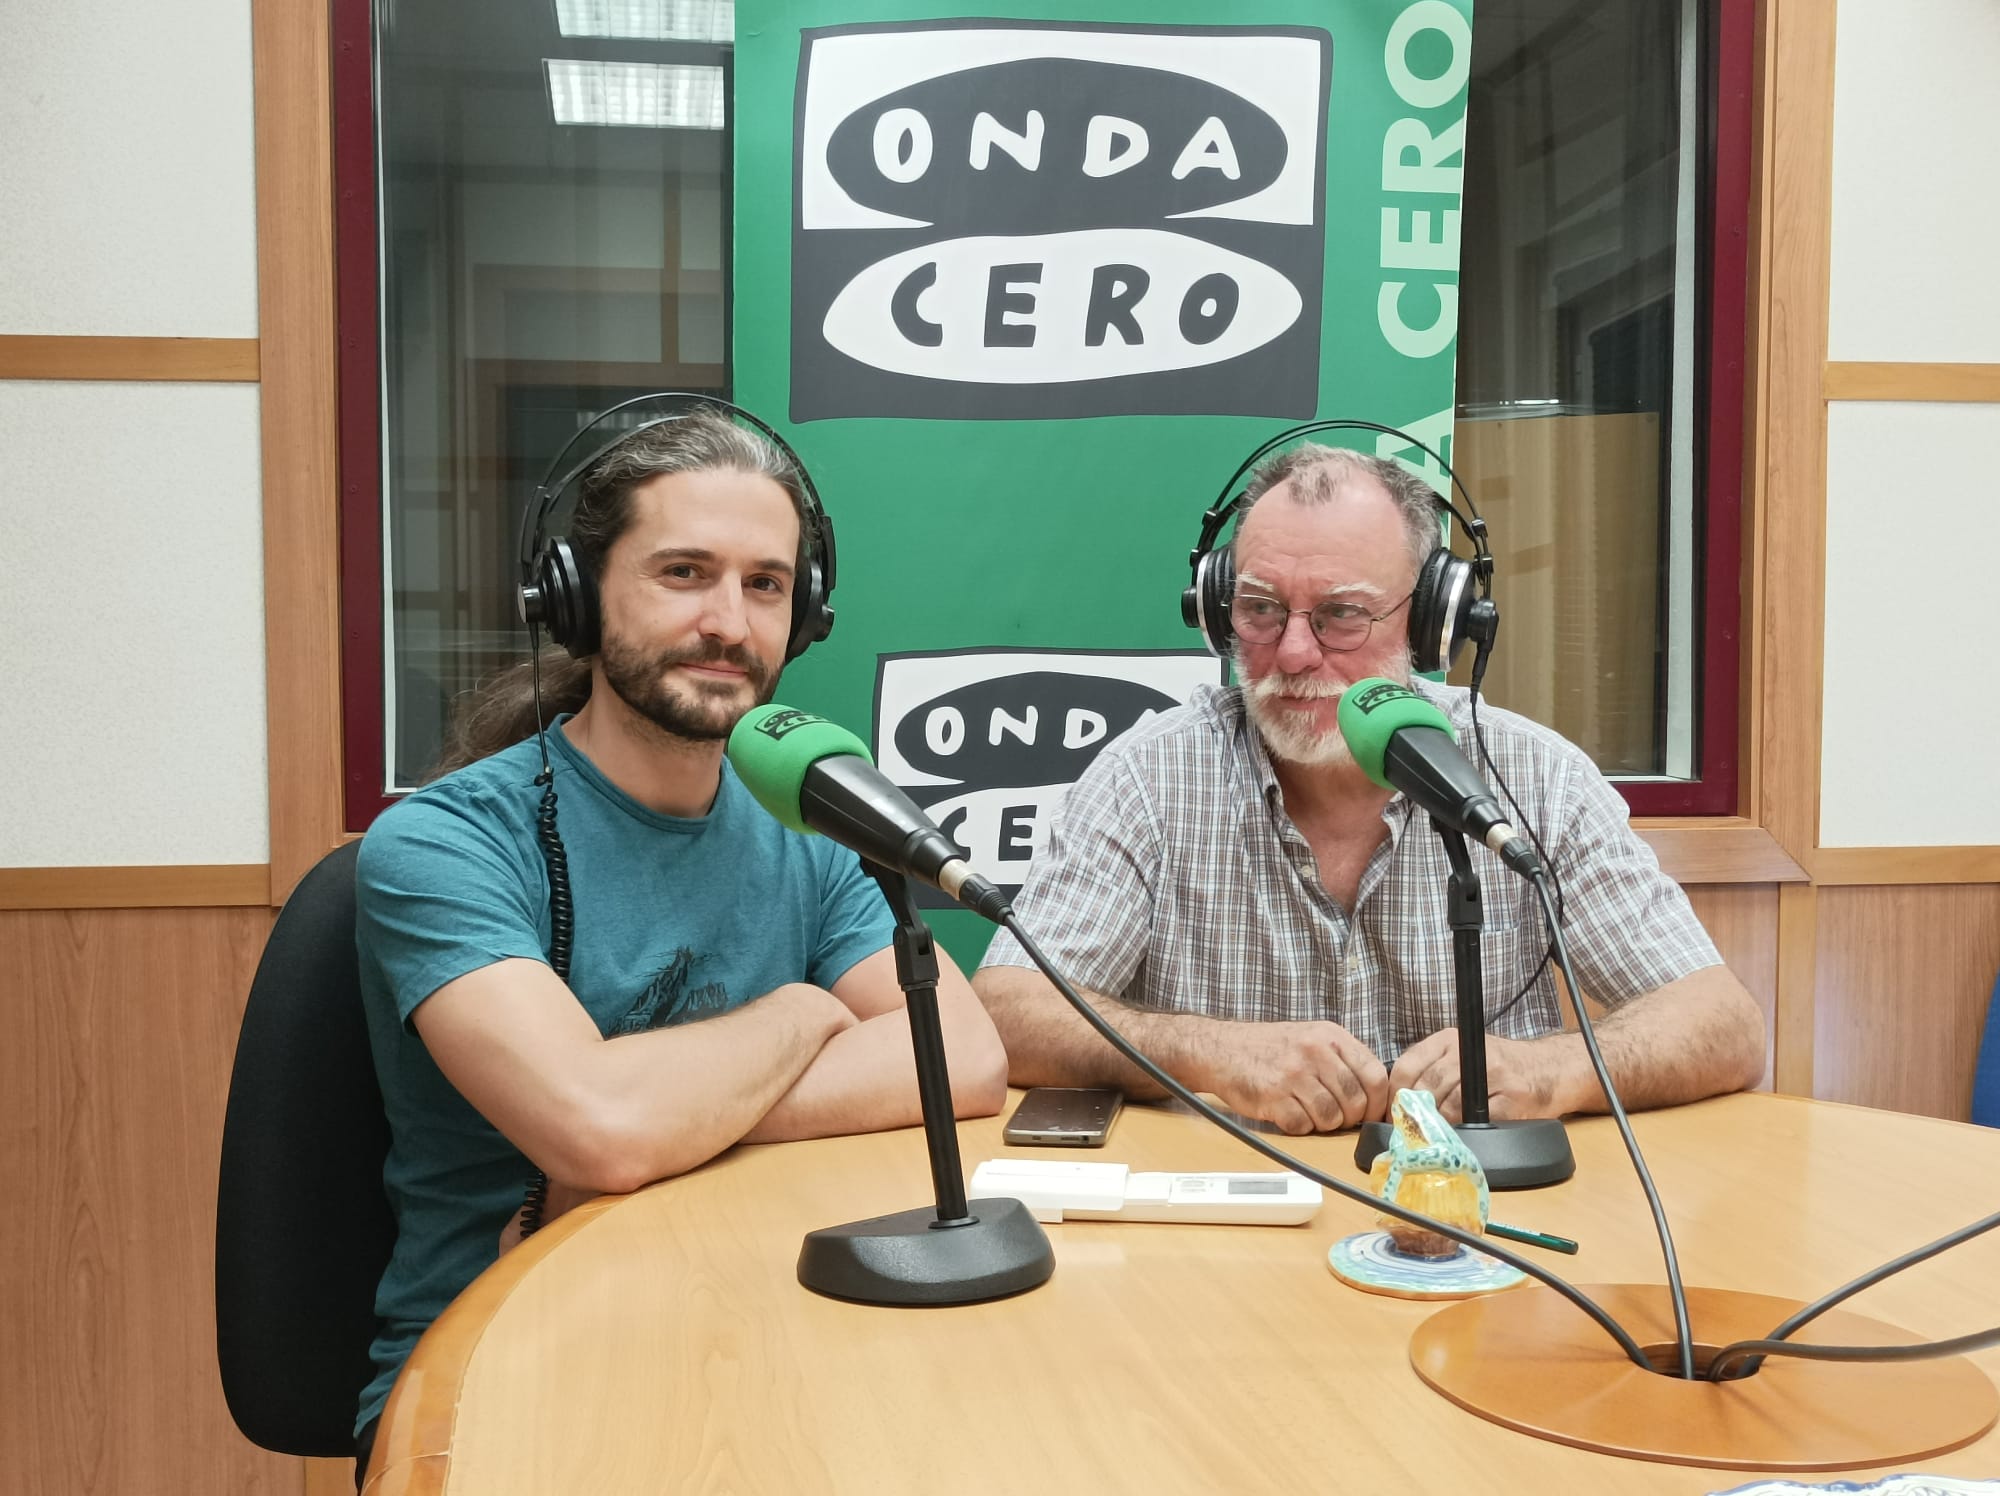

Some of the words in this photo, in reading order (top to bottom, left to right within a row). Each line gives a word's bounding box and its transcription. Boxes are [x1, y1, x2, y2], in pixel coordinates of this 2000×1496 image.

[872, 108, 1241, 183] ONDA
[1377, 0, 1472, 358] CERO
[890, 262, 1240, 347] CERO
[925, 705, 1159, 756] OND
[938, 804, 1038, 863] CE
